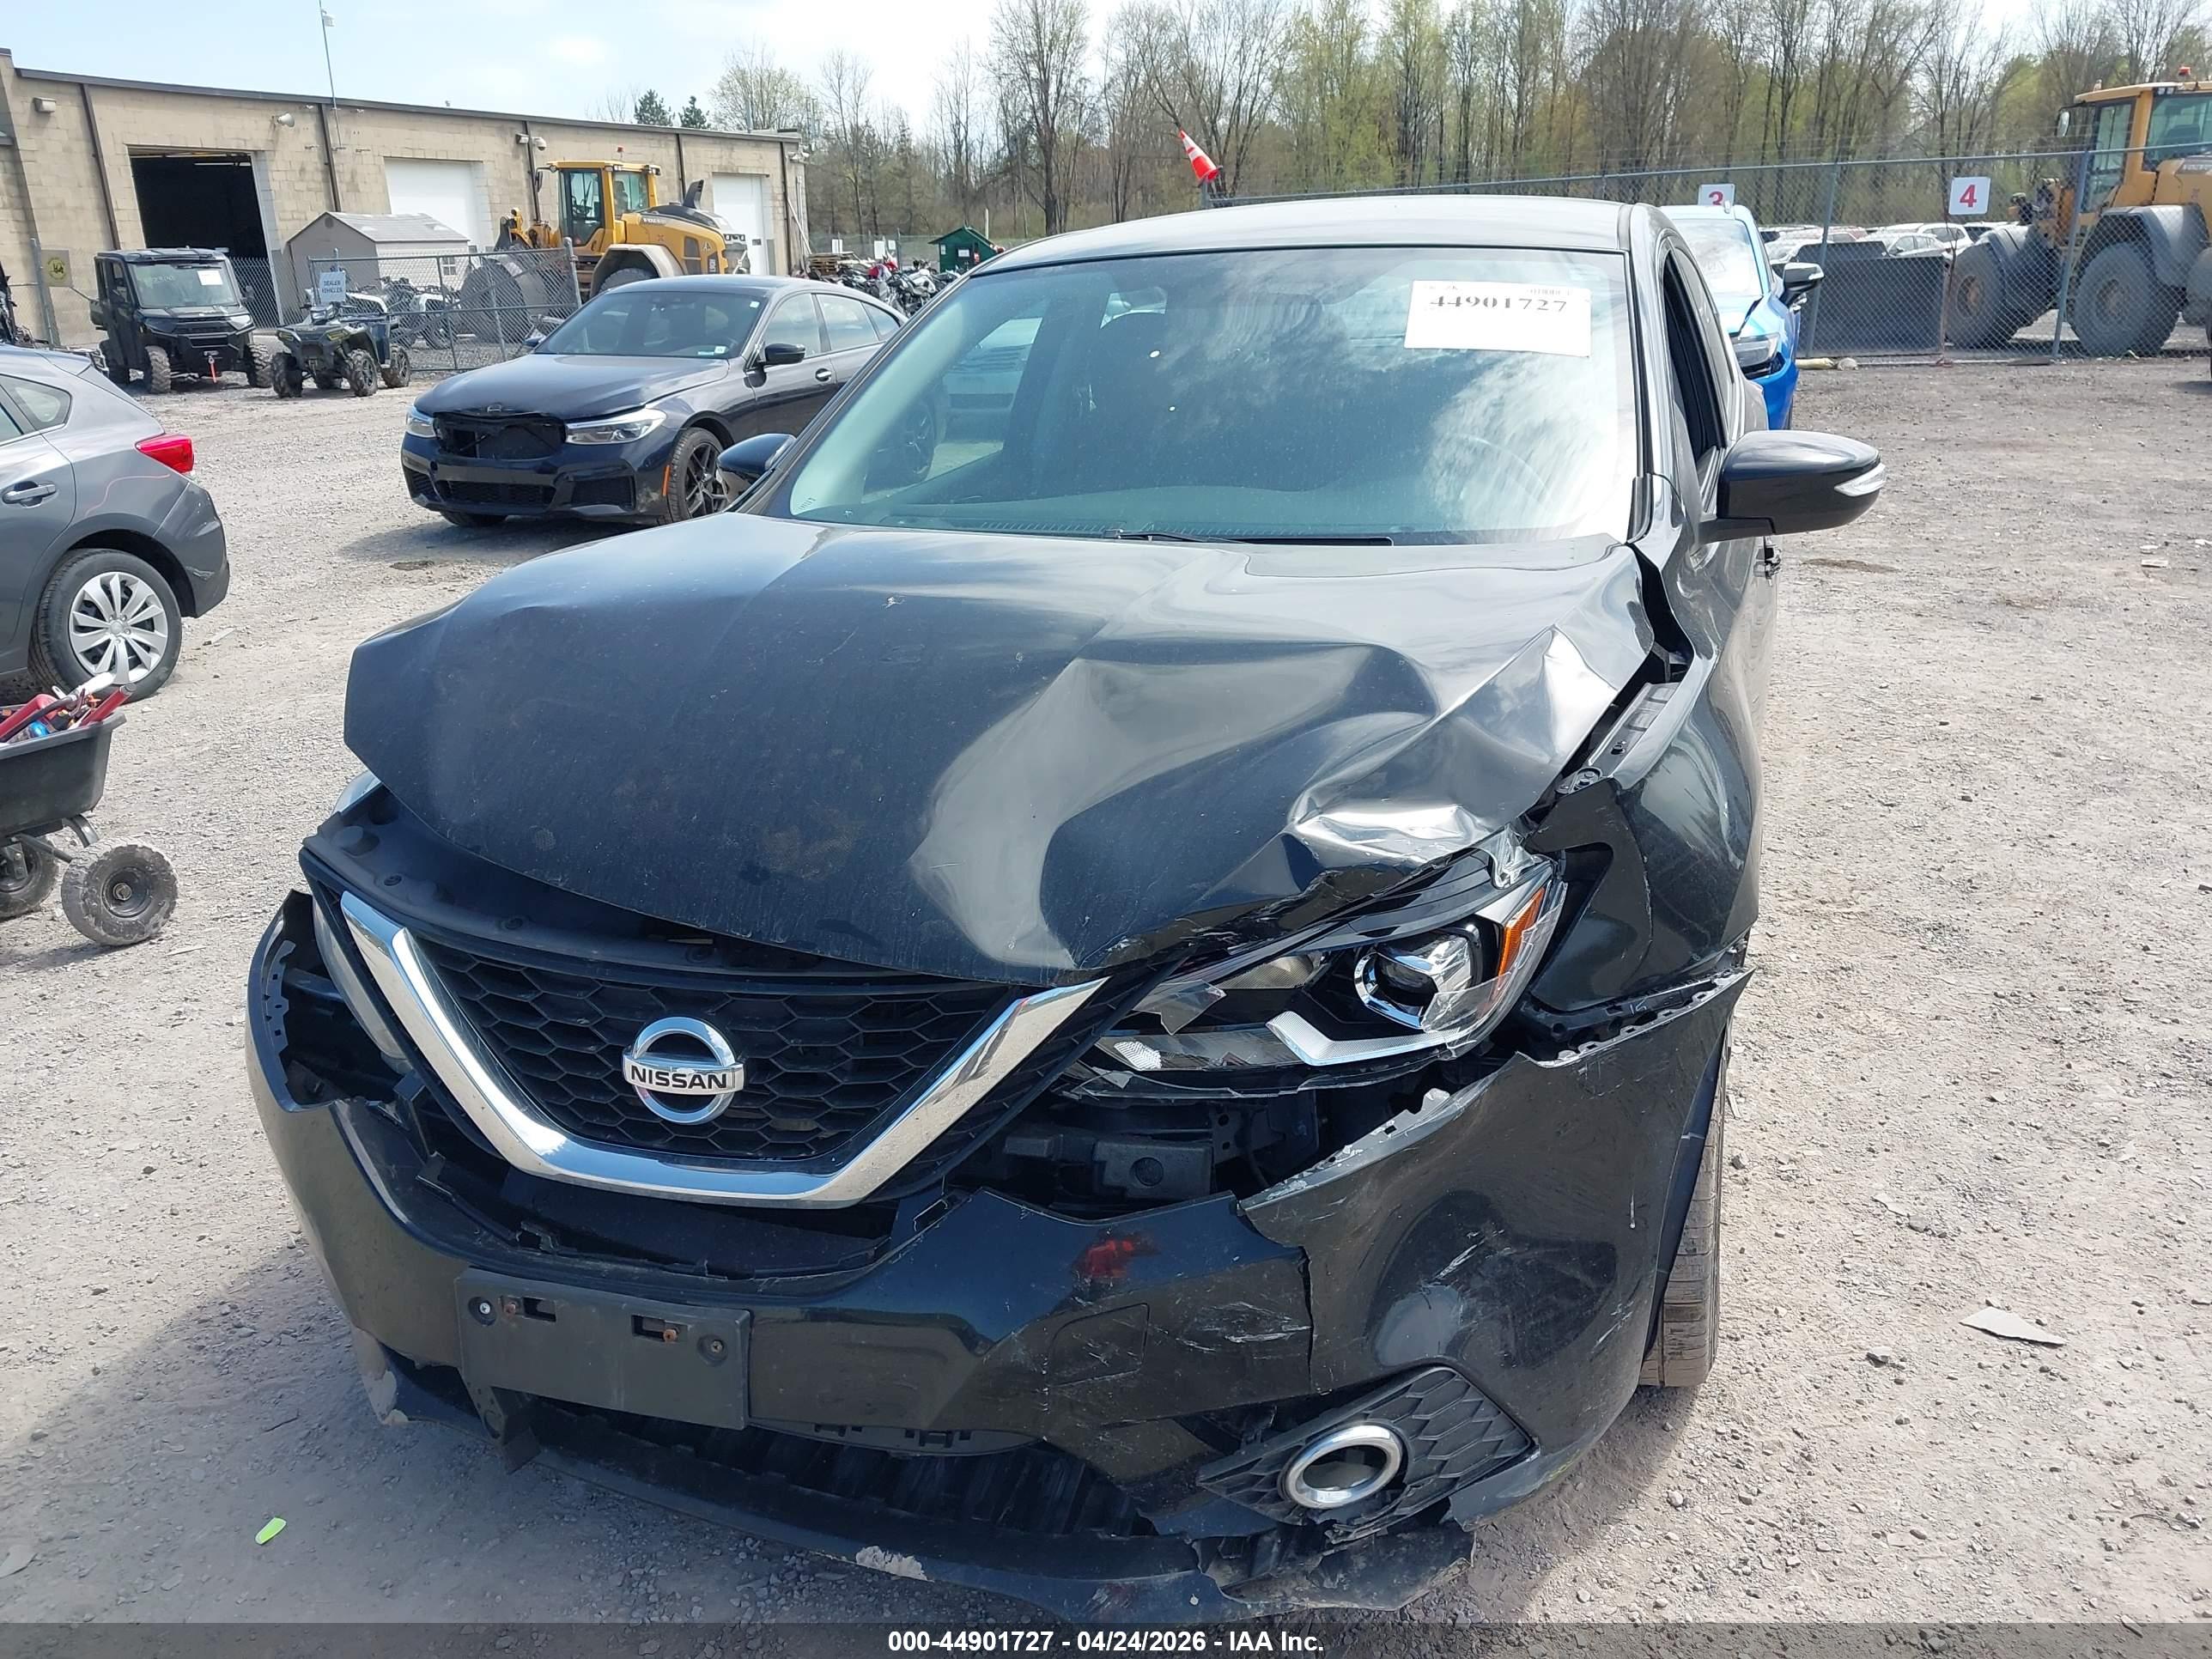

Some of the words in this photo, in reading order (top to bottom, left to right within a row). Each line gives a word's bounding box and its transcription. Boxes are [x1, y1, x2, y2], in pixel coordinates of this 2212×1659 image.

[1708, 191, 1724, 206] 3
[1959, 184, 1978, 208] 4
[1430, 295, 1567, 312] 44901727
[631, 1065, 727, 1090] NISSAN
